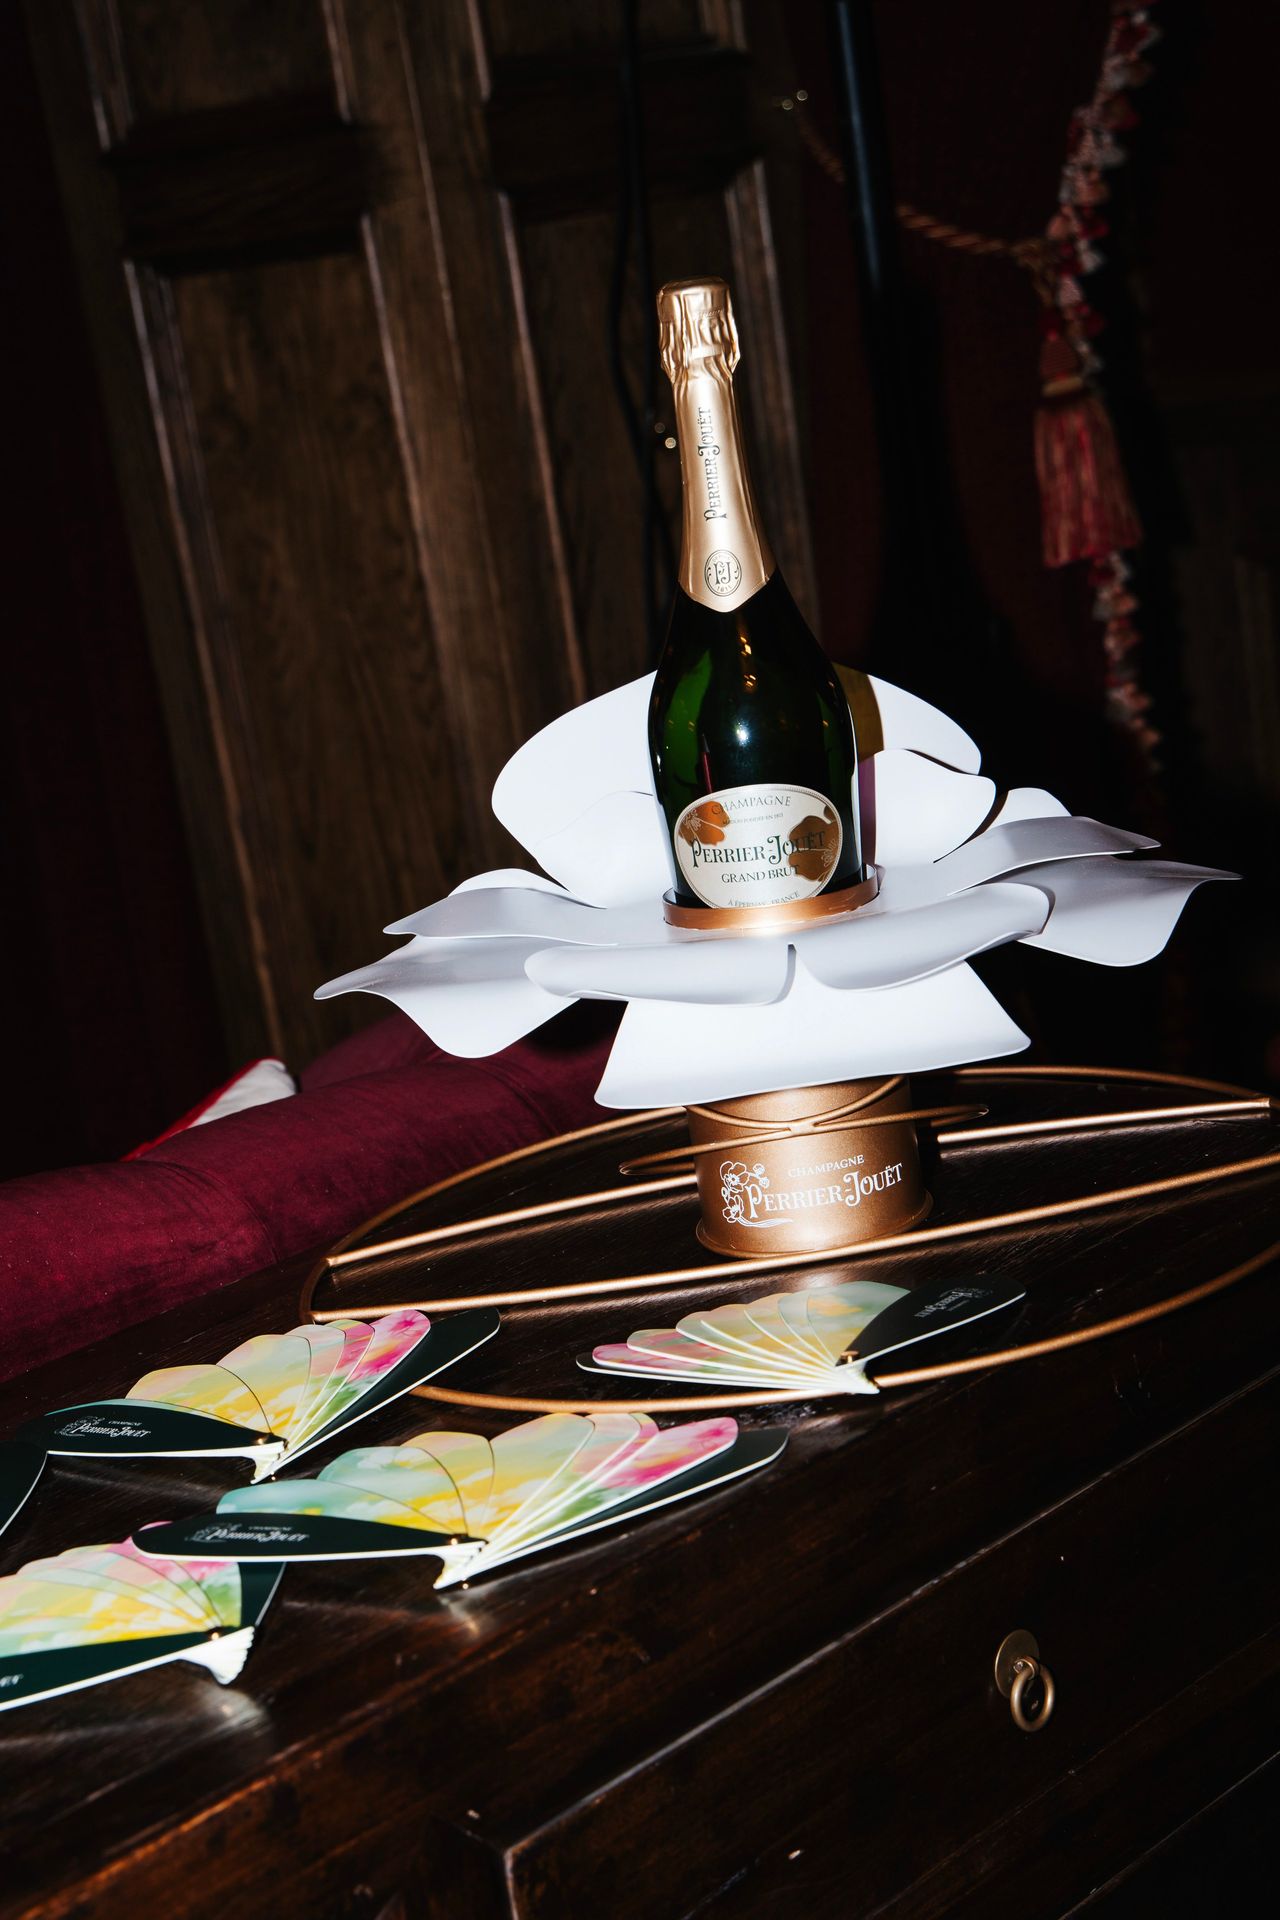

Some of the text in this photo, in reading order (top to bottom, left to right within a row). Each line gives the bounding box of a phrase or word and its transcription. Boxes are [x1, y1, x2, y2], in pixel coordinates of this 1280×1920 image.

[697, 406, 728, 522] PERRIER-JOUËT
[711, 795, 792, 815] CHAMPAGNE
[721, 864, 800, 884] GRAND BRUT
[788, 1154, 865, 1178] CHAMPAGNE
[744, 1162, 903, 1219] PERRIER-JOUËT
